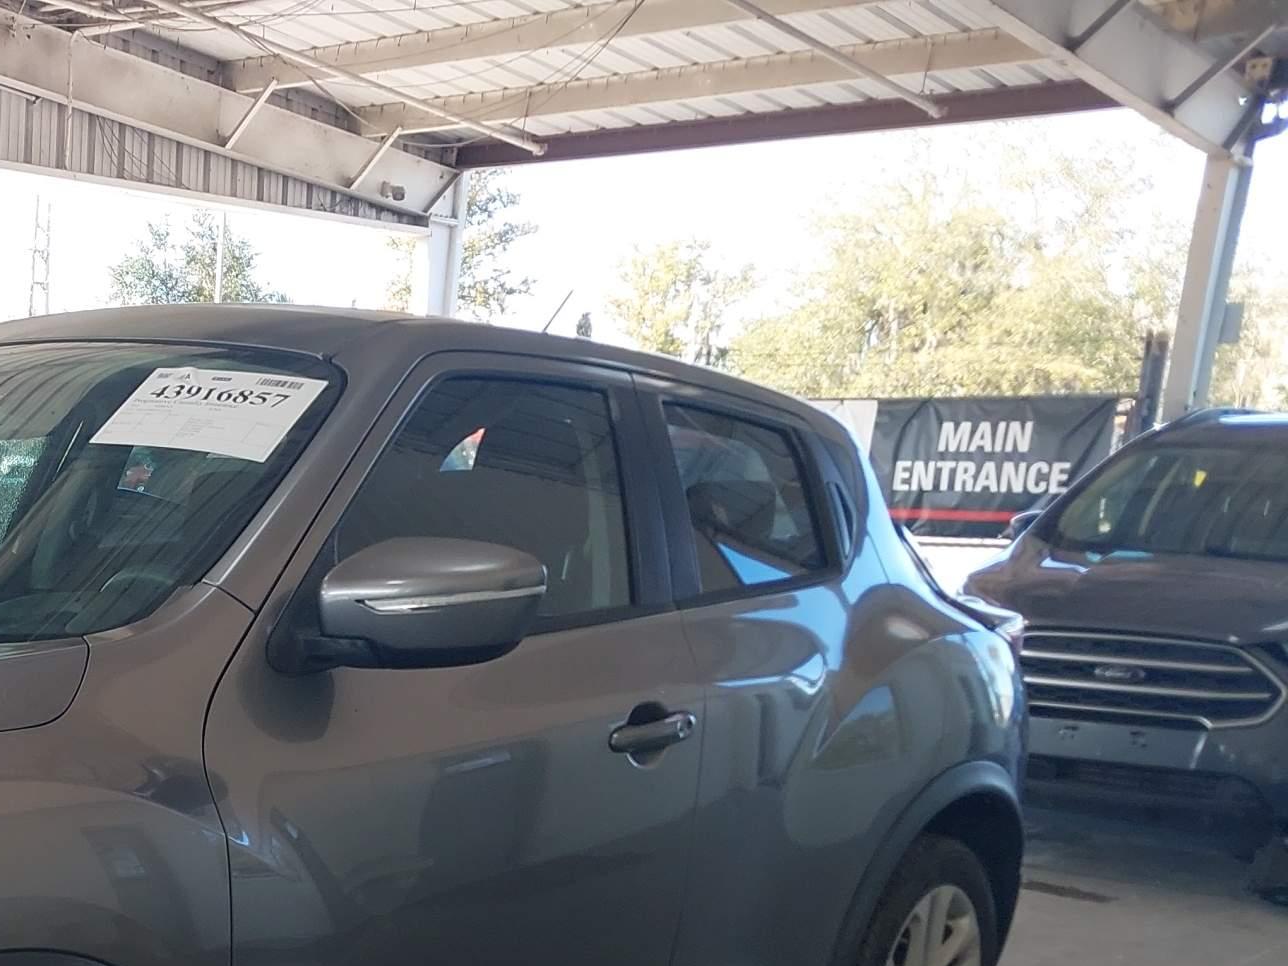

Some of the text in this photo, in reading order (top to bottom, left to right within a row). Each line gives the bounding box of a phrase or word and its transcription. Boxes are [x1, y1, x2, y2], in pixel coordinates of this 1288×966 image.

[149, 384, 291, 409] 43916857
[937, 421, 1034, 452] MAIN
[892, 460, 1071, 494] ENTRANCE
